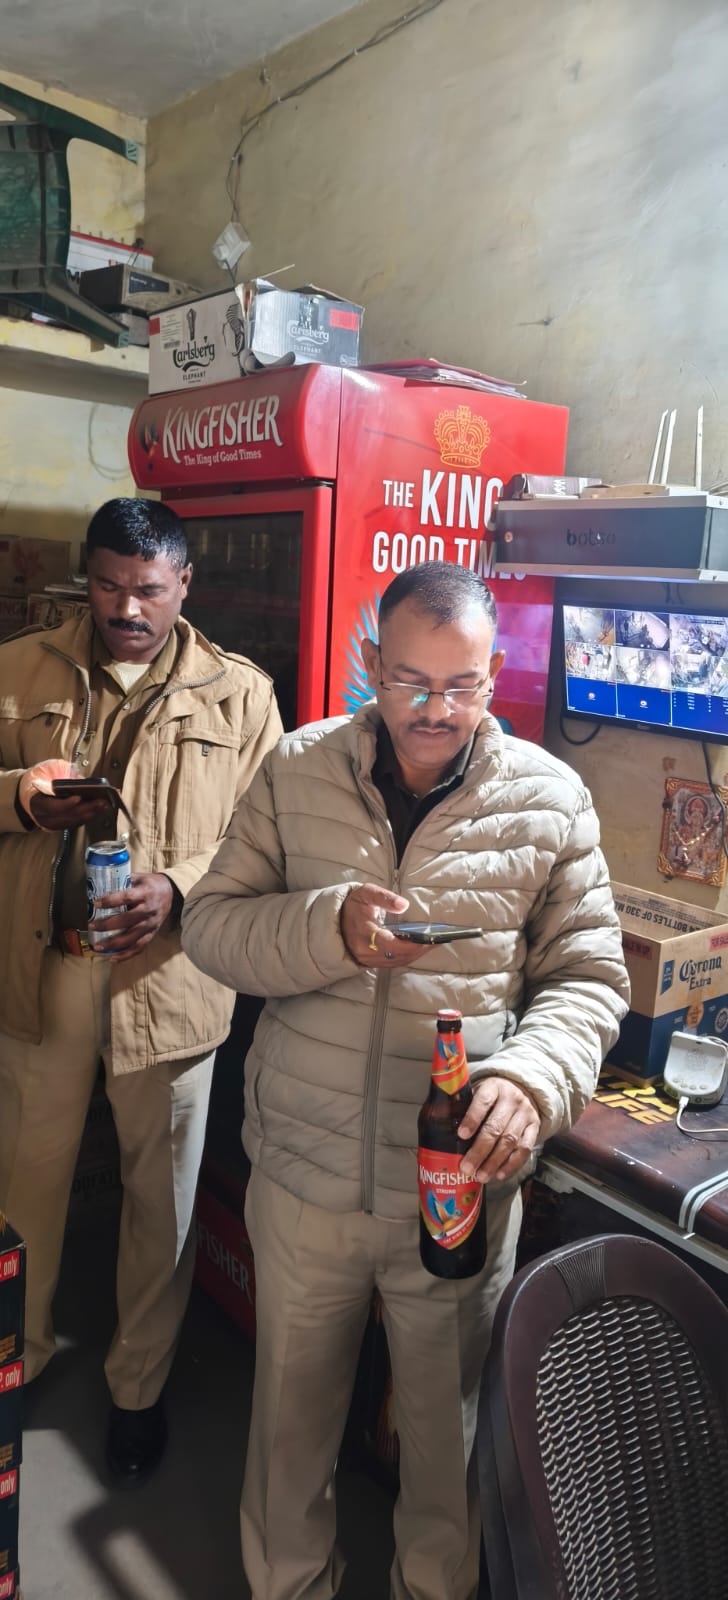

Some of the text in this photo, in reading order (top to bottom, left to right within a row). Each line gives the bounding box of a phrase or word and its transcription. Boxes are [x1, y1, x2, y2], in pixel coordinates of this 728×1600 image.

[173, 336, 215, 368] Carlsberg
[182, 371, 206, 381] ELEPHANT
[163, 395, 283, 463] KINGFISHER
[184, 448, 262, 467] The King of Good Times
[383, 479, 415, 508] THE
[372, 530, 526, 581] GOOD TIM
[625, 906, 641, 917] 330
[641, 910, 652, 921] OF
[653, 914, 688, 932] BOTTLES
[679, 956, 722, 981] Corona
[688, 977, 712, 990] Extra
[592, 1093, 673, 1125] IFE
[3, 1254, 18, 1277] only
[5, 1366, 21, 1387] only
[1, 1475, 15, 1493] only
